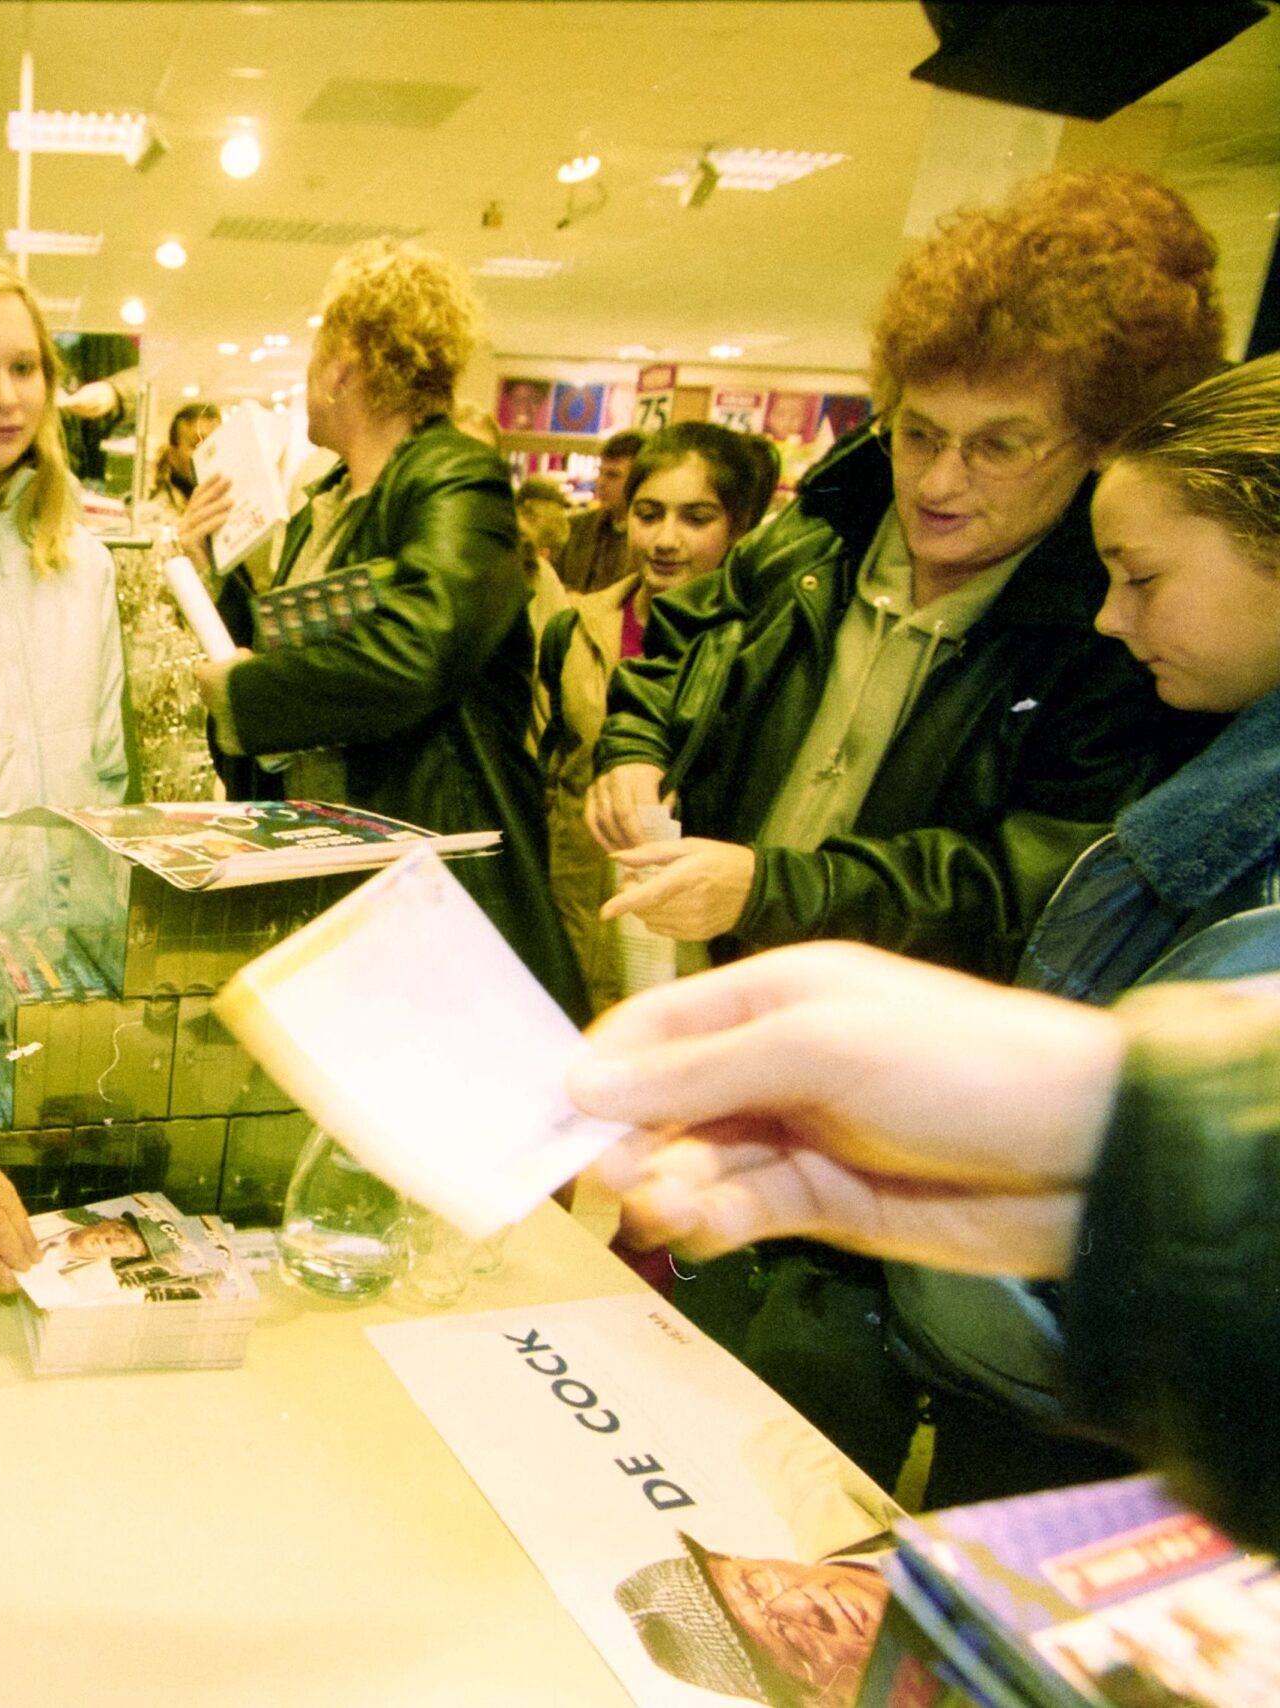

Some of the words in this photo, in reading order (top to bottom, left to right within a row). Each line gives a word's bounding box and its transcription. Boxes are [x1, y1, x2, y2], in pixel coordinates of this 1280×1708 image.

[639, 396, 669, 429] 75
[502, 1328, 621, 1434] COCK
[613, 1454, 697, 1511] DE
